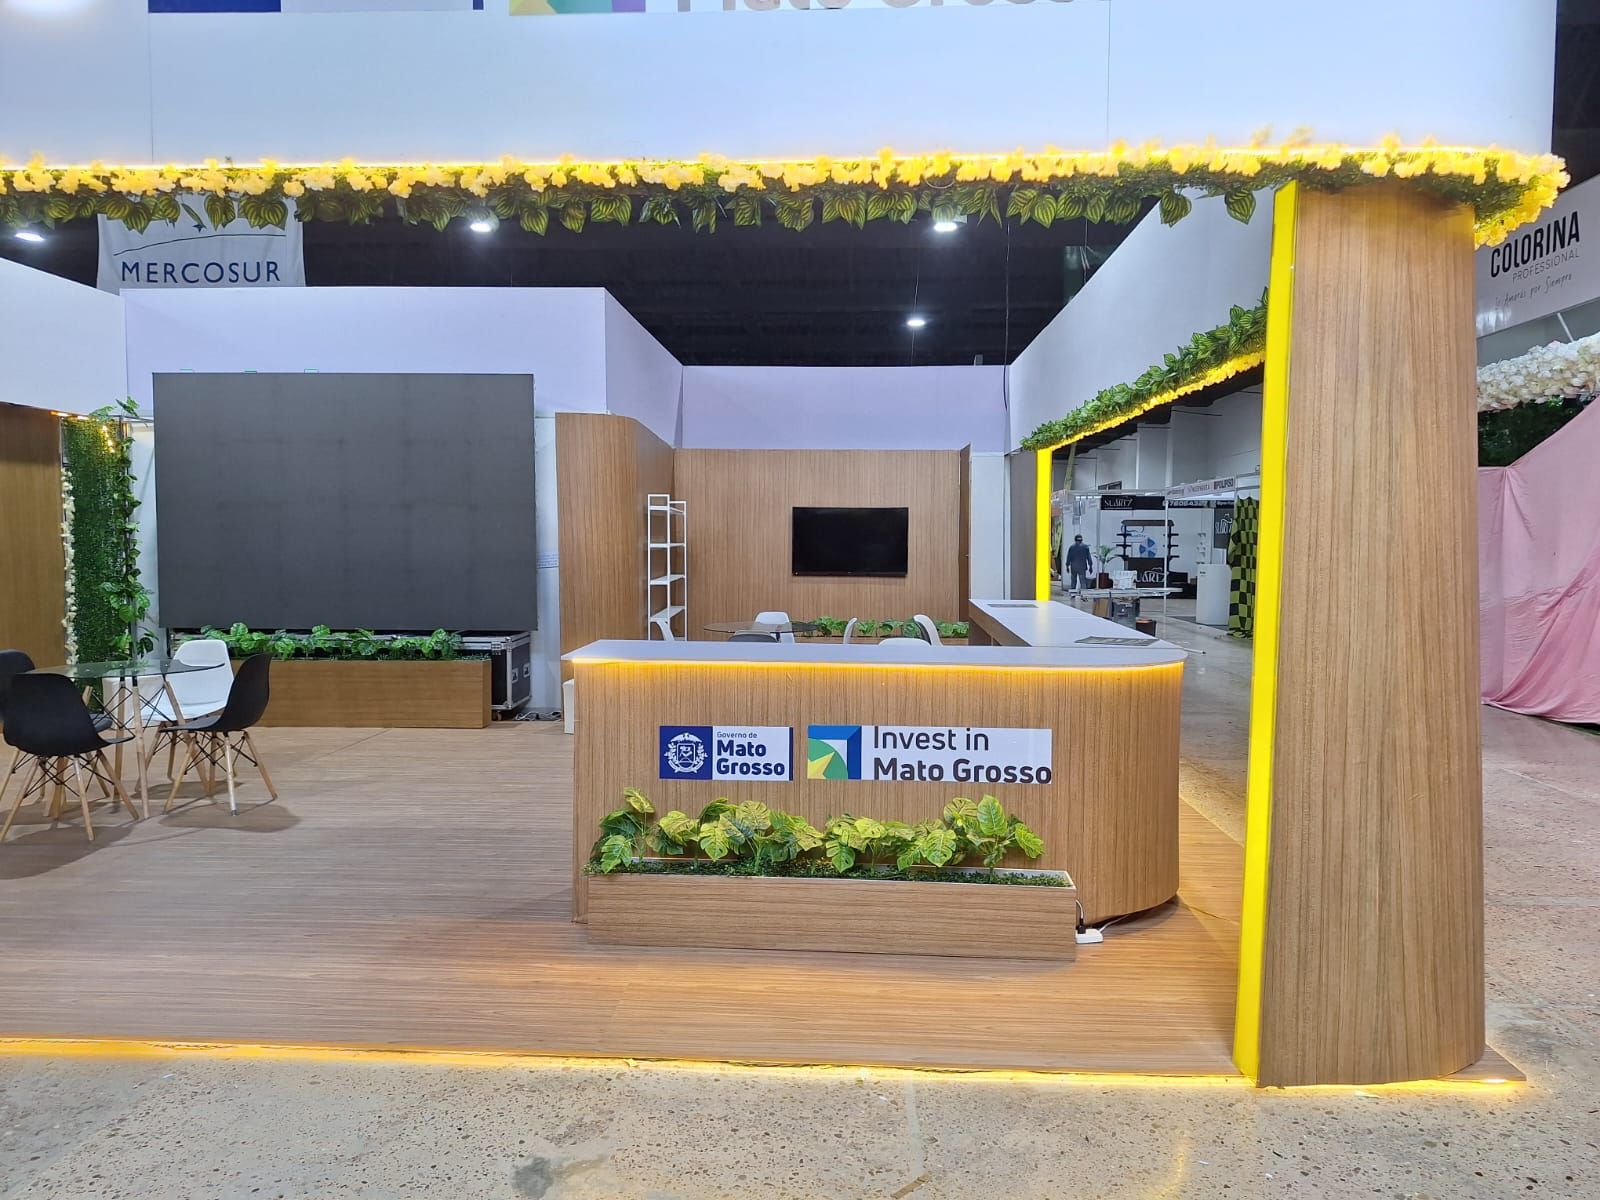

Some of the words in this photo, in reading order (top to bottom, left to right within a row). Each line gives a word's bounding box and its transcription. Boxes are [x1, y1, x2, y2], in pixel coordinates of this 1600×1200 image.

[1490, 211, 1580, 278] COLORINA
[121, 261, 281, 283] MERCOSUR
[1512, 249, 1580, 282] PROFESSIONAL
[716, 731, 747, 739] Governo
[748, 731, 758, 739] de
[873, 726, 957, 750] Invest
[966, 727, 989, 751] in
[716, 739, 767, 757] Mato
[716, 758, 785, 775] Grosso
[873, 757, 945, 781] Mato
[953, 758, 1052, 784] Grosso
